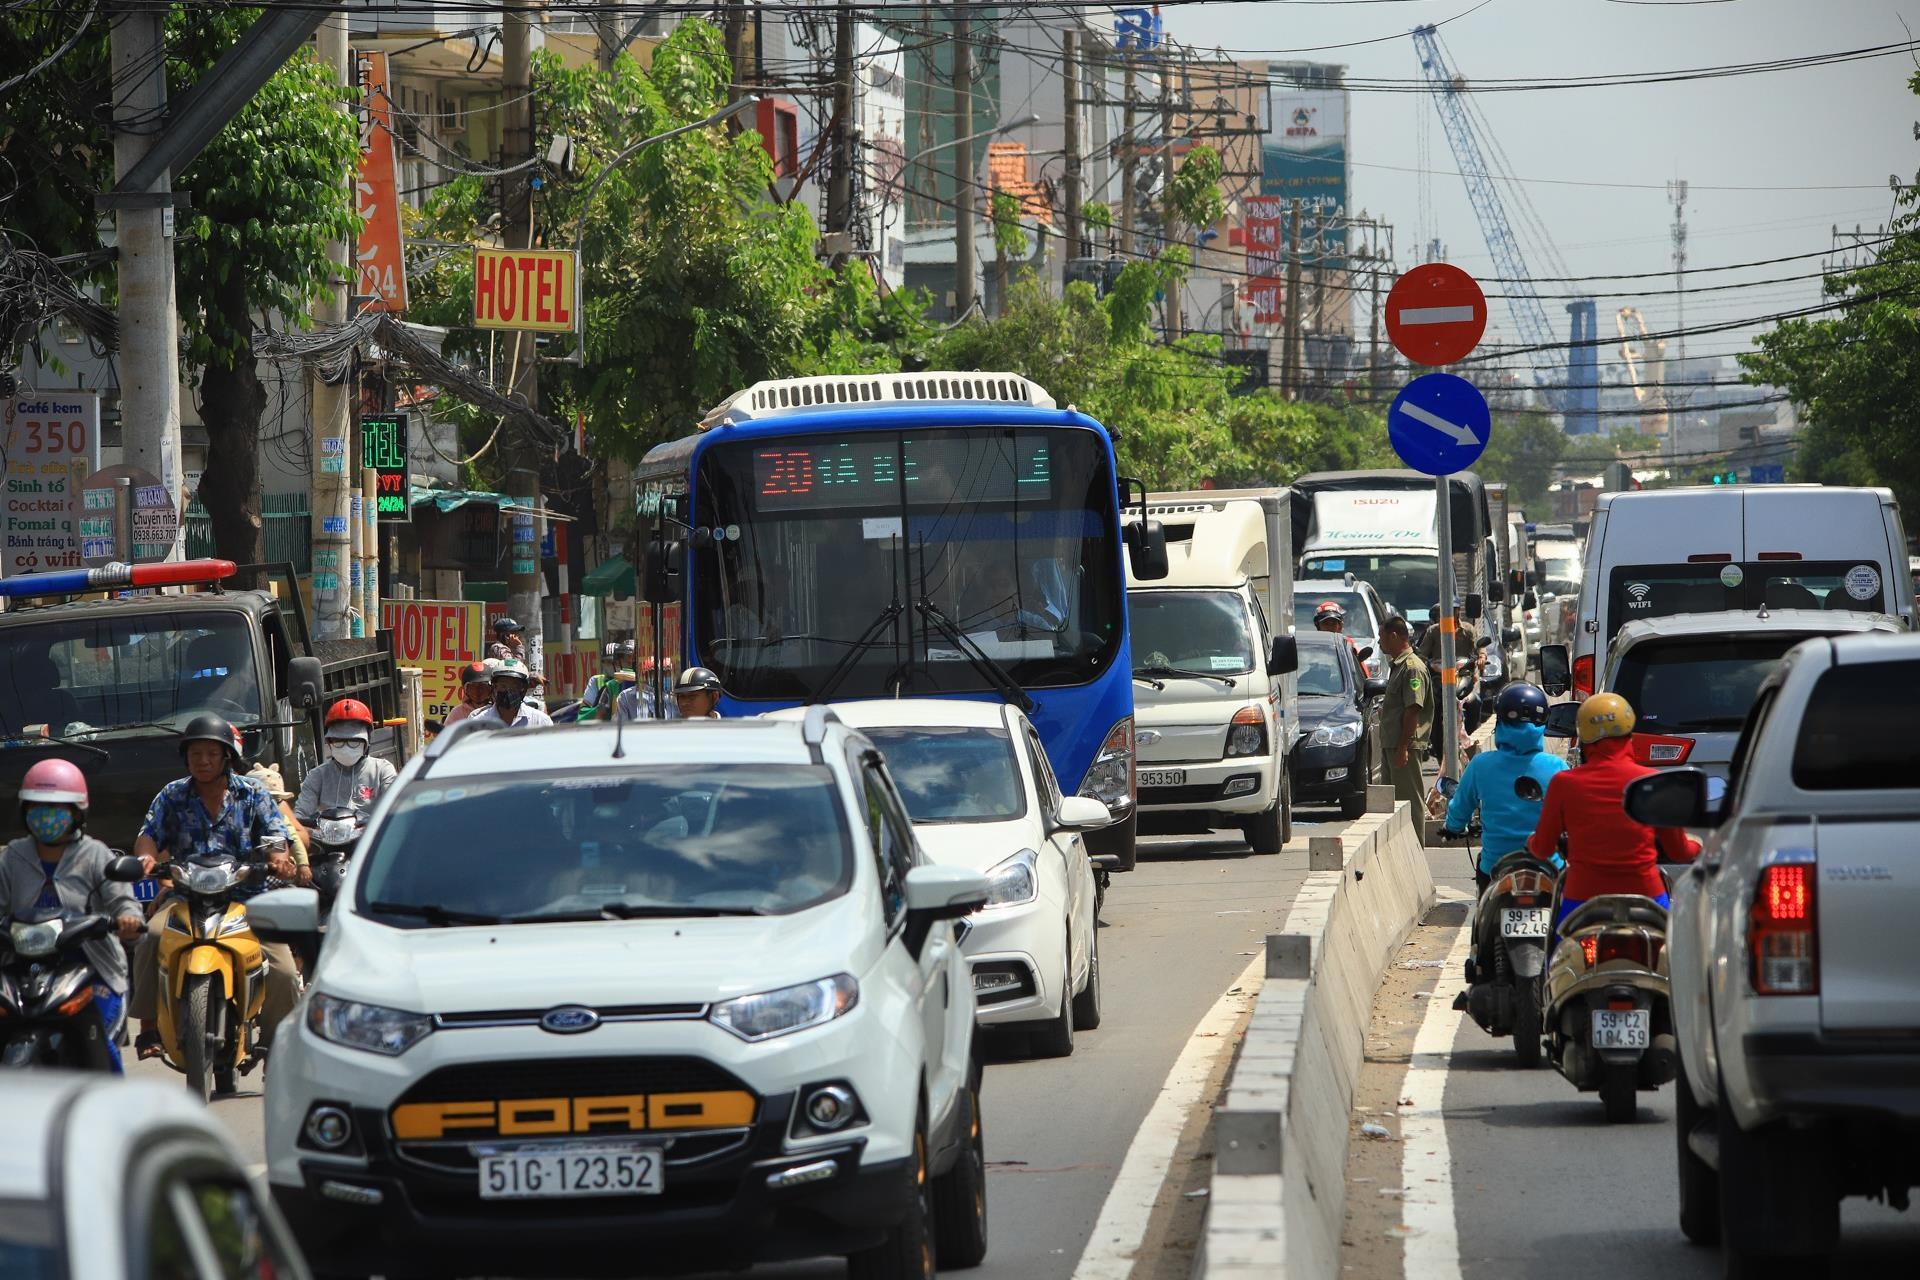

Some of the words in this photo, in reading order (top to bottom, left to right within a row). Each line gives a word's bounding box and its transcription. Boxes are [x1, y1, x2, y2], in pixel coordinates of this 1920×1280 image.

[476, 255, 569, 323] HOTEL
[17, 402, 49, 414] Café
[52, 402, 82, 414] kem
[25, 421, 86, 453] 350
[7, 480, 42, 492] Sinh
[48, 478, 66, 492] tố
[8, 500, 64, 512] Cocktai
[378, 496, 404, 512] 24/24
[8, 518, 56, 530] Fomai
[162, 510, 176, 525] nhà
[7, 535, 34, 547] Bánh
[37, 535, 65, 549] tráng
[133, 529, 176, 540] 0938.663.707
[16, 552, 38, 567] có
[45, 551, 82, 567] wifi
[383, 603, 475, 661] HOTEL
[1508, 910, 1544, 922] 99-E1
[1504, 923, 1548, 935] 042.46
[552, 1010, 593, 1027] Ford
[1601, 1012, 1640, 1028] 59-C2
[1595, 1030, 1646, 1046] 184.59
[392, 1090, 756, 1138] FORD
[488, 1156, 653, 1192] 51G-123.52
